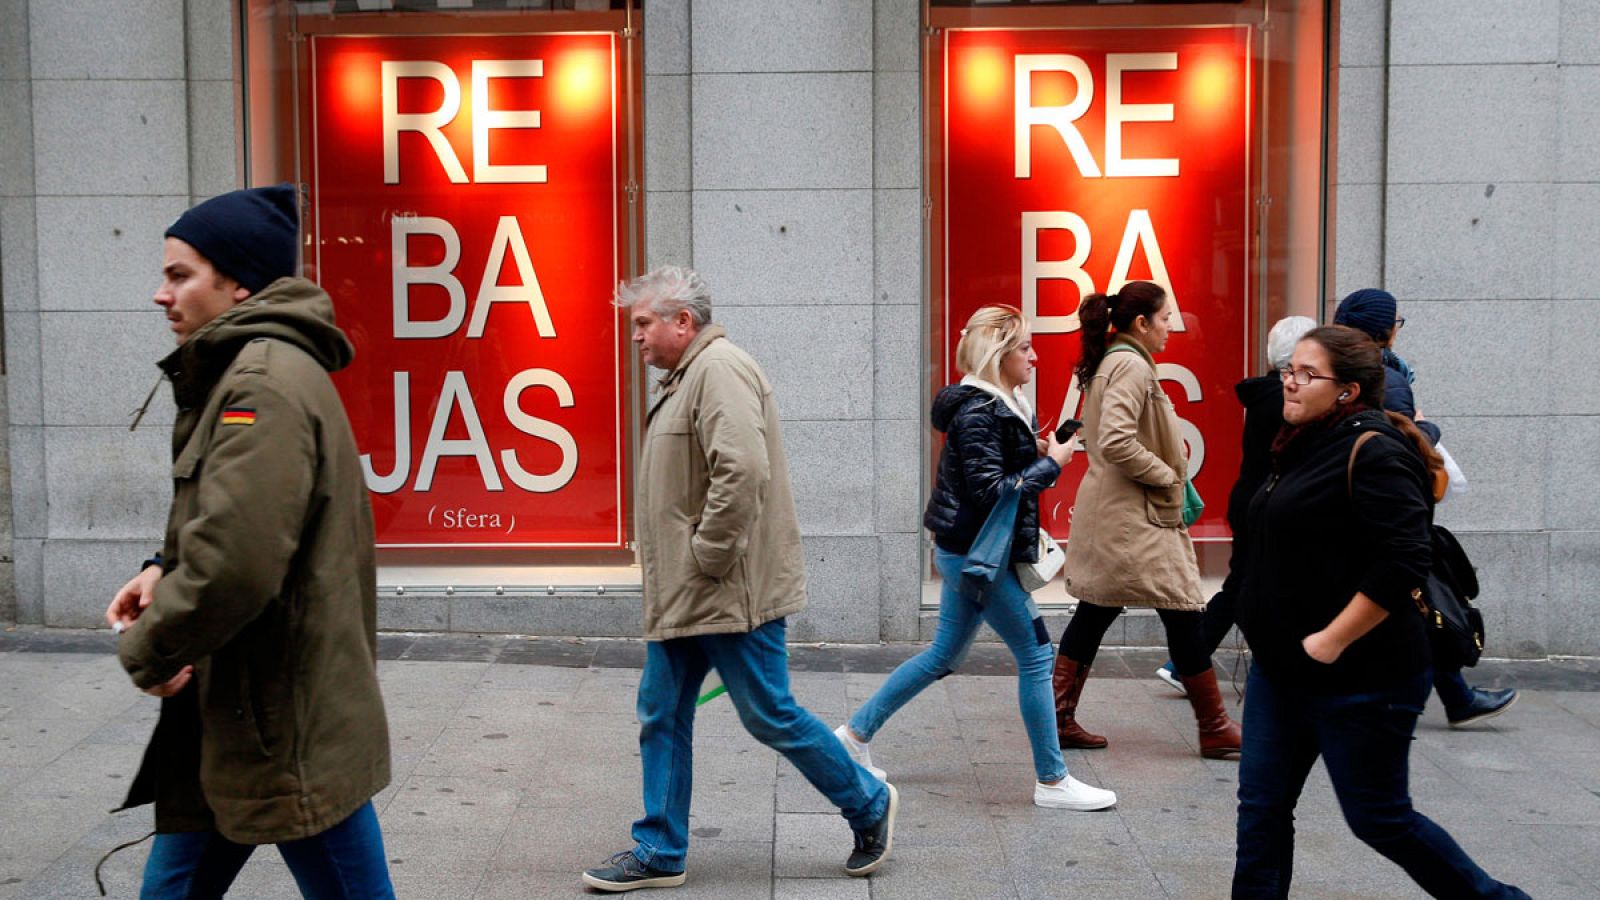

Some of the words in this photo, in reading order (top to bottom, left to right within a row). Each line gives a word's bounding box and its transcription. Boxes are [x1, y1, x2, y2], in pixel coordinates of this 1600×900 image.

[381, 59, 548, 184] RE
[1014, 52, 1181, 179] RE
[391, 215, 557, 339] BA
[1021, 209, 1186, 334] BA
[359, 368, 579, 493] JAS
